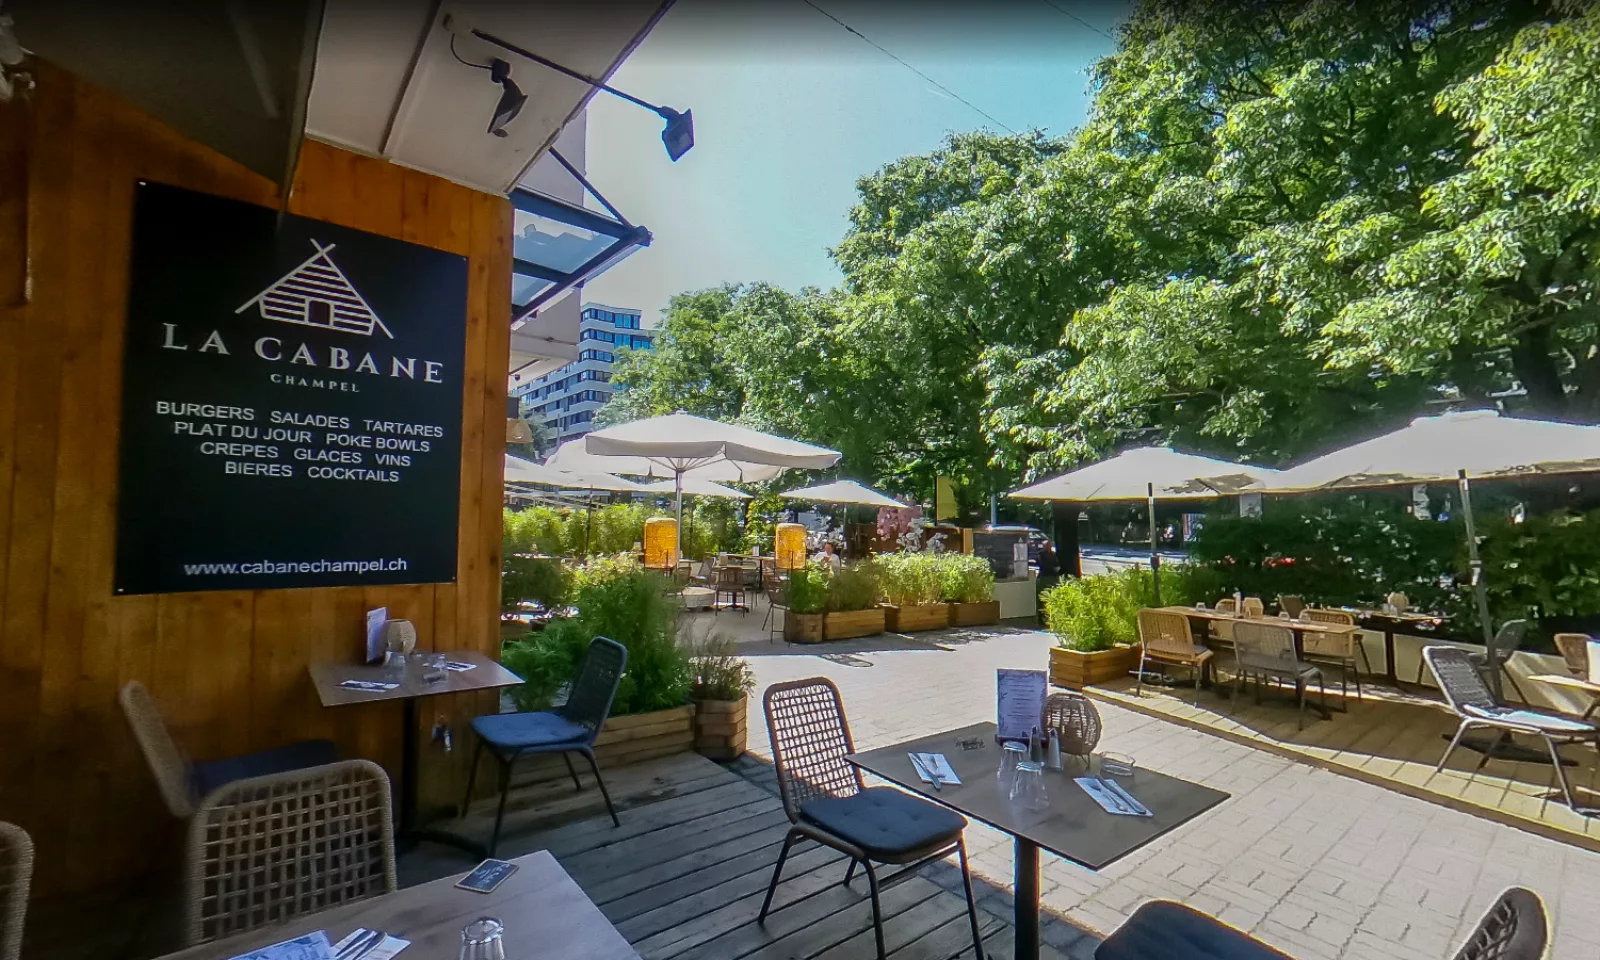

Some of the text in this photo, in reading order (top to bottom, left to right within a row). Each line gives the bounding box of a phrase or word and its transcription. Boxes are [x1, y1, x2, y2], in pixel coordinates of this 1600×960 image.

[162, 323, 443, 383] LA CABANE
[271, 374, 359, 392] CHAMPEL
[157, 401, 443, 437] BURGERS SALADES TARTARES
[175, 422, 429, 452] PLAT DU JOUR POKE BOWLS
[201, 442, 410, 466] CREPES GLACES VINS
[225, 462, 399, 482] BIERES COCKTAILS
[184, 558, 406, 574] www.cabanechampel.ch
